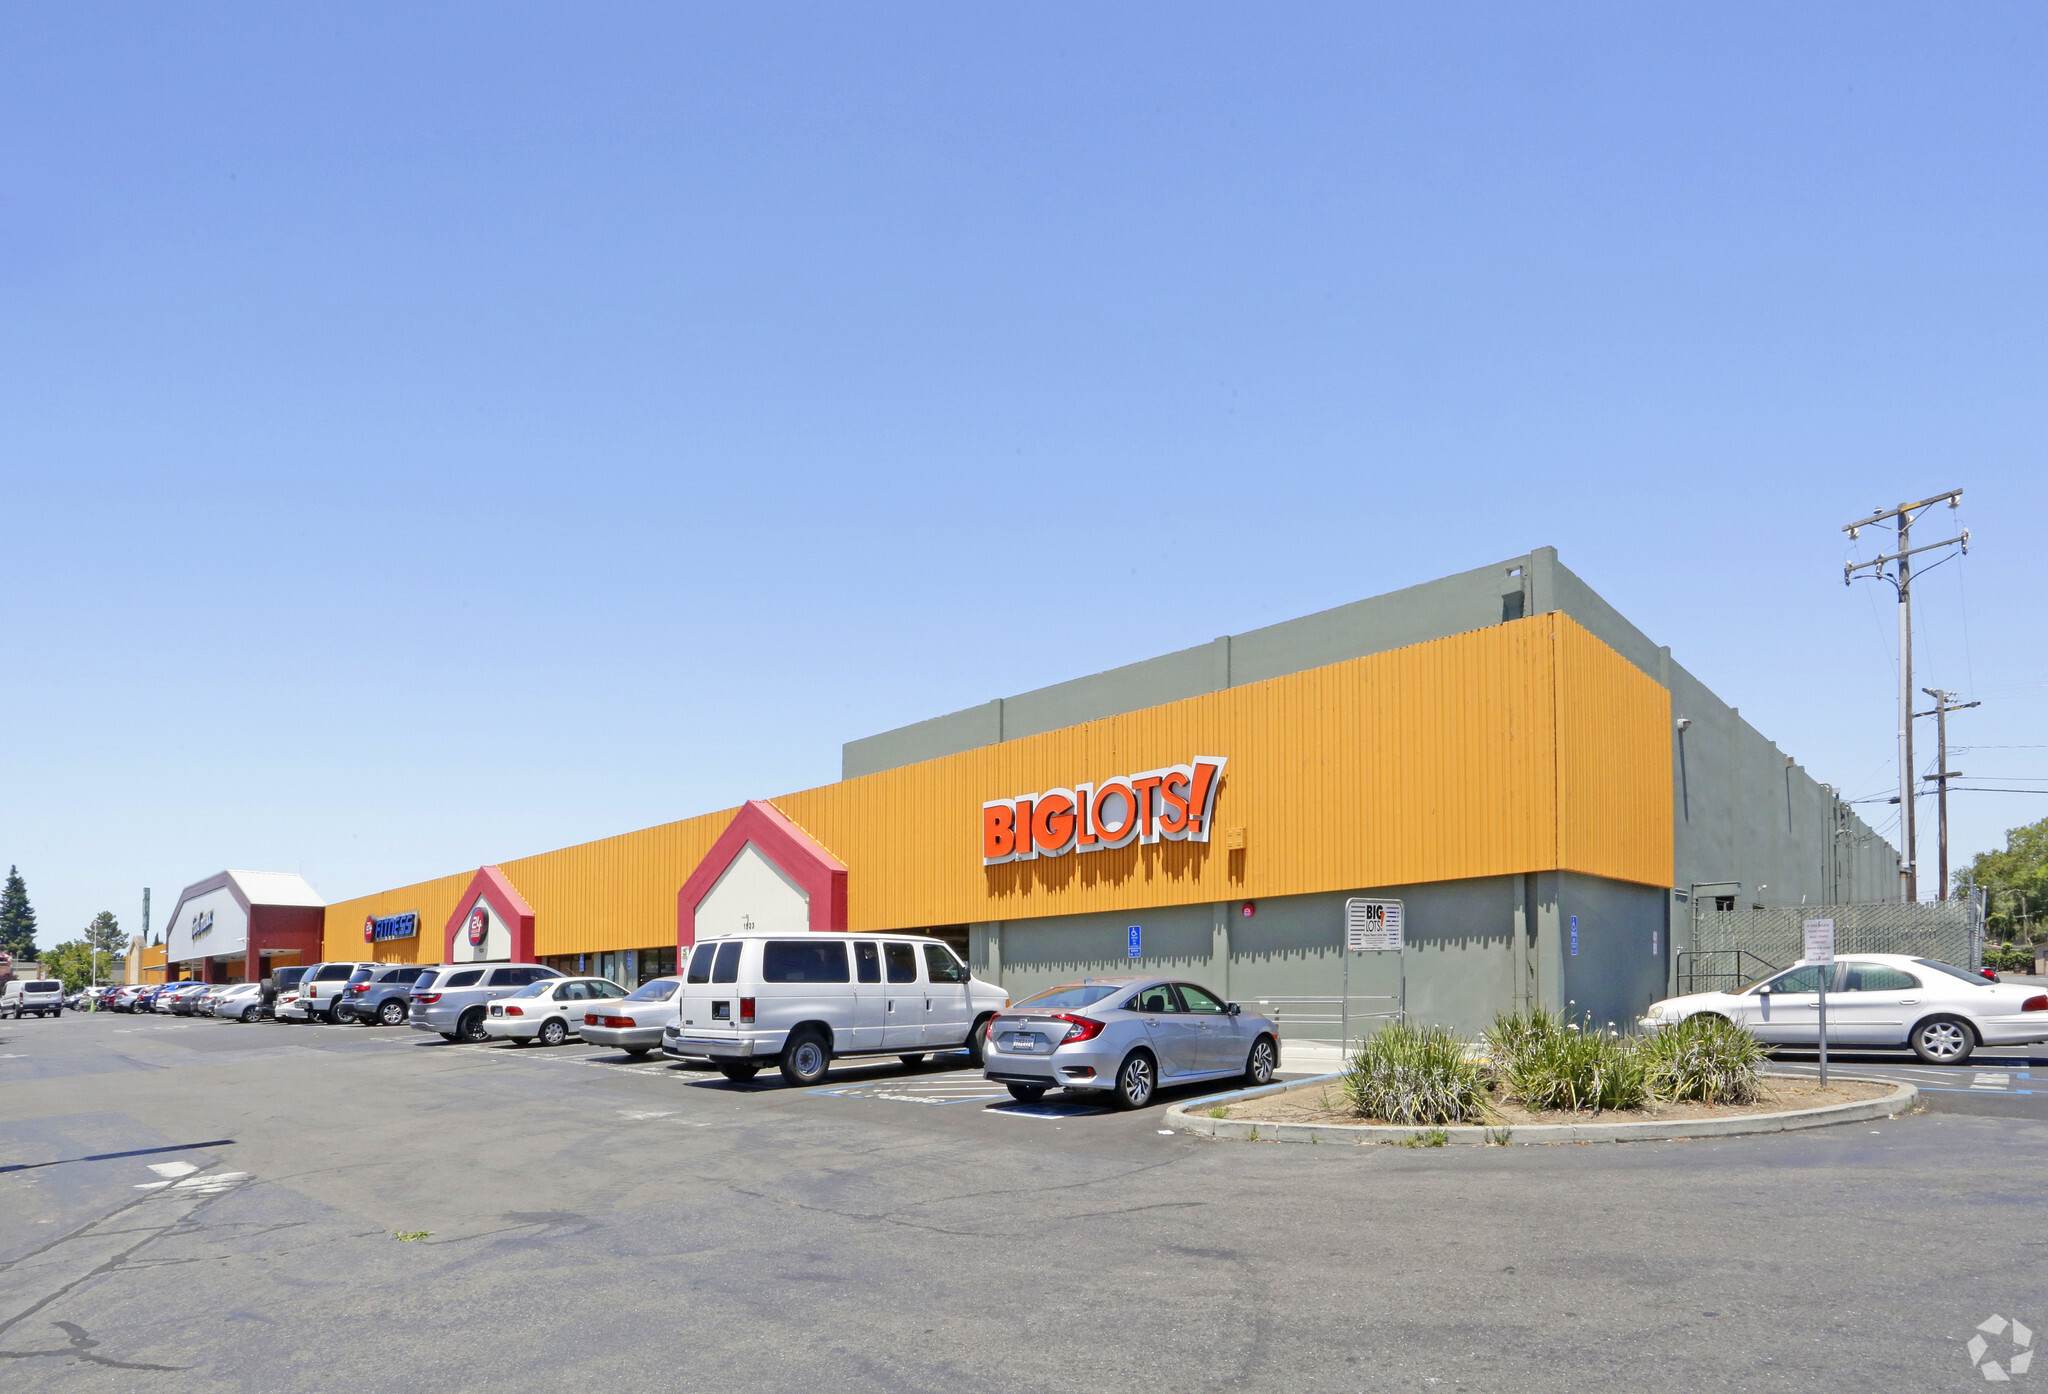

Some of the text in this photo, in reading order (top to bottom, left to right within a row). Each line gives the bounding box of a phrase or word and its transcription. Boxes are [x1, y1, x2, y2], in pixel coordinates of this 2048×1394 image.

[1367, 905, 1383, 919] BIG
[375, 914, 413, 938] FITNESS
[471, 915, 482, 932] 24
